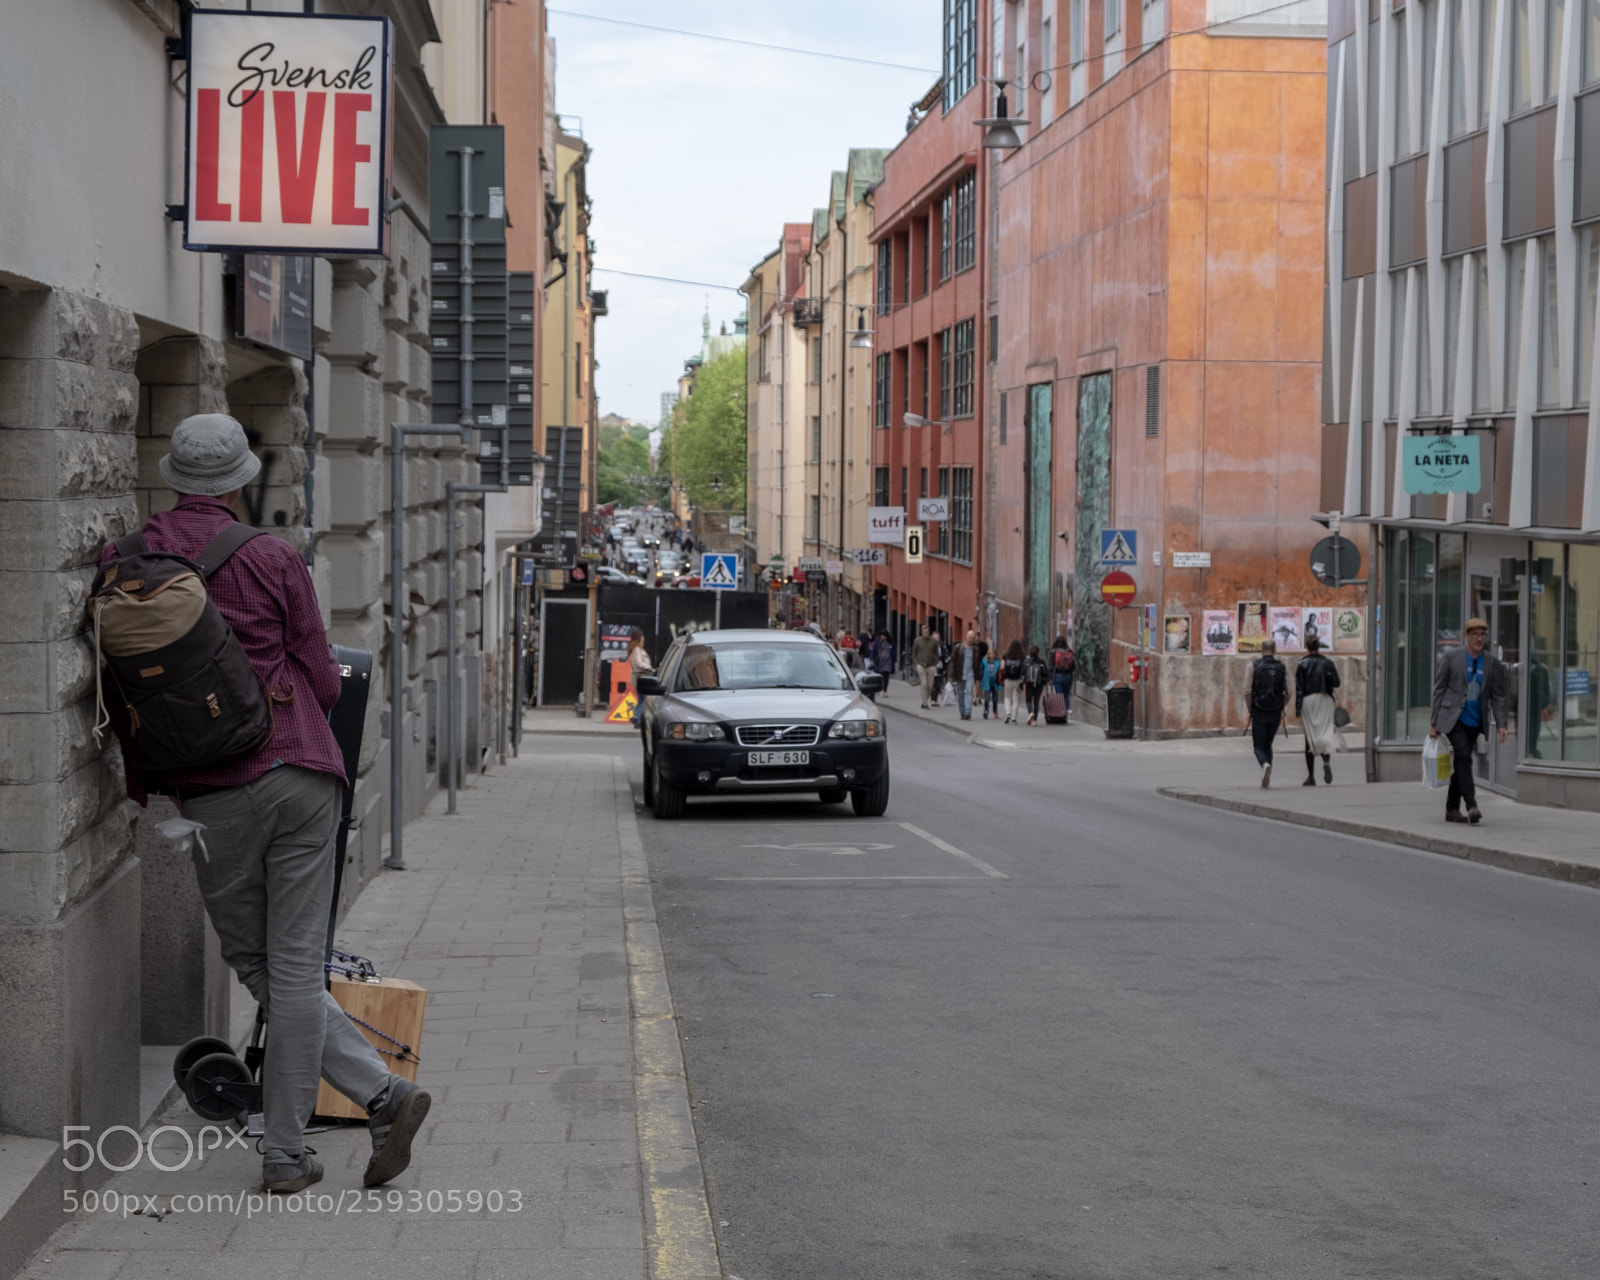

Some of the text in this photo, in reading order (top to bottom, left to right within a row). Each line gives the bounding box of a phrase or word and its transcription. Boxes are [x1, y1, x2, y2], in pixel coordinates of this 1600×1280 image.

[227, 42, 377, 108] Svensk
[195, 88, 373, 227] LIVE
[1415, 454, 1470, 465] LA NETA
[922, 503, 945, 515] ROA
[872, 516, 900, 528] tuff
[750, 752, 808, 764] SLF 630
